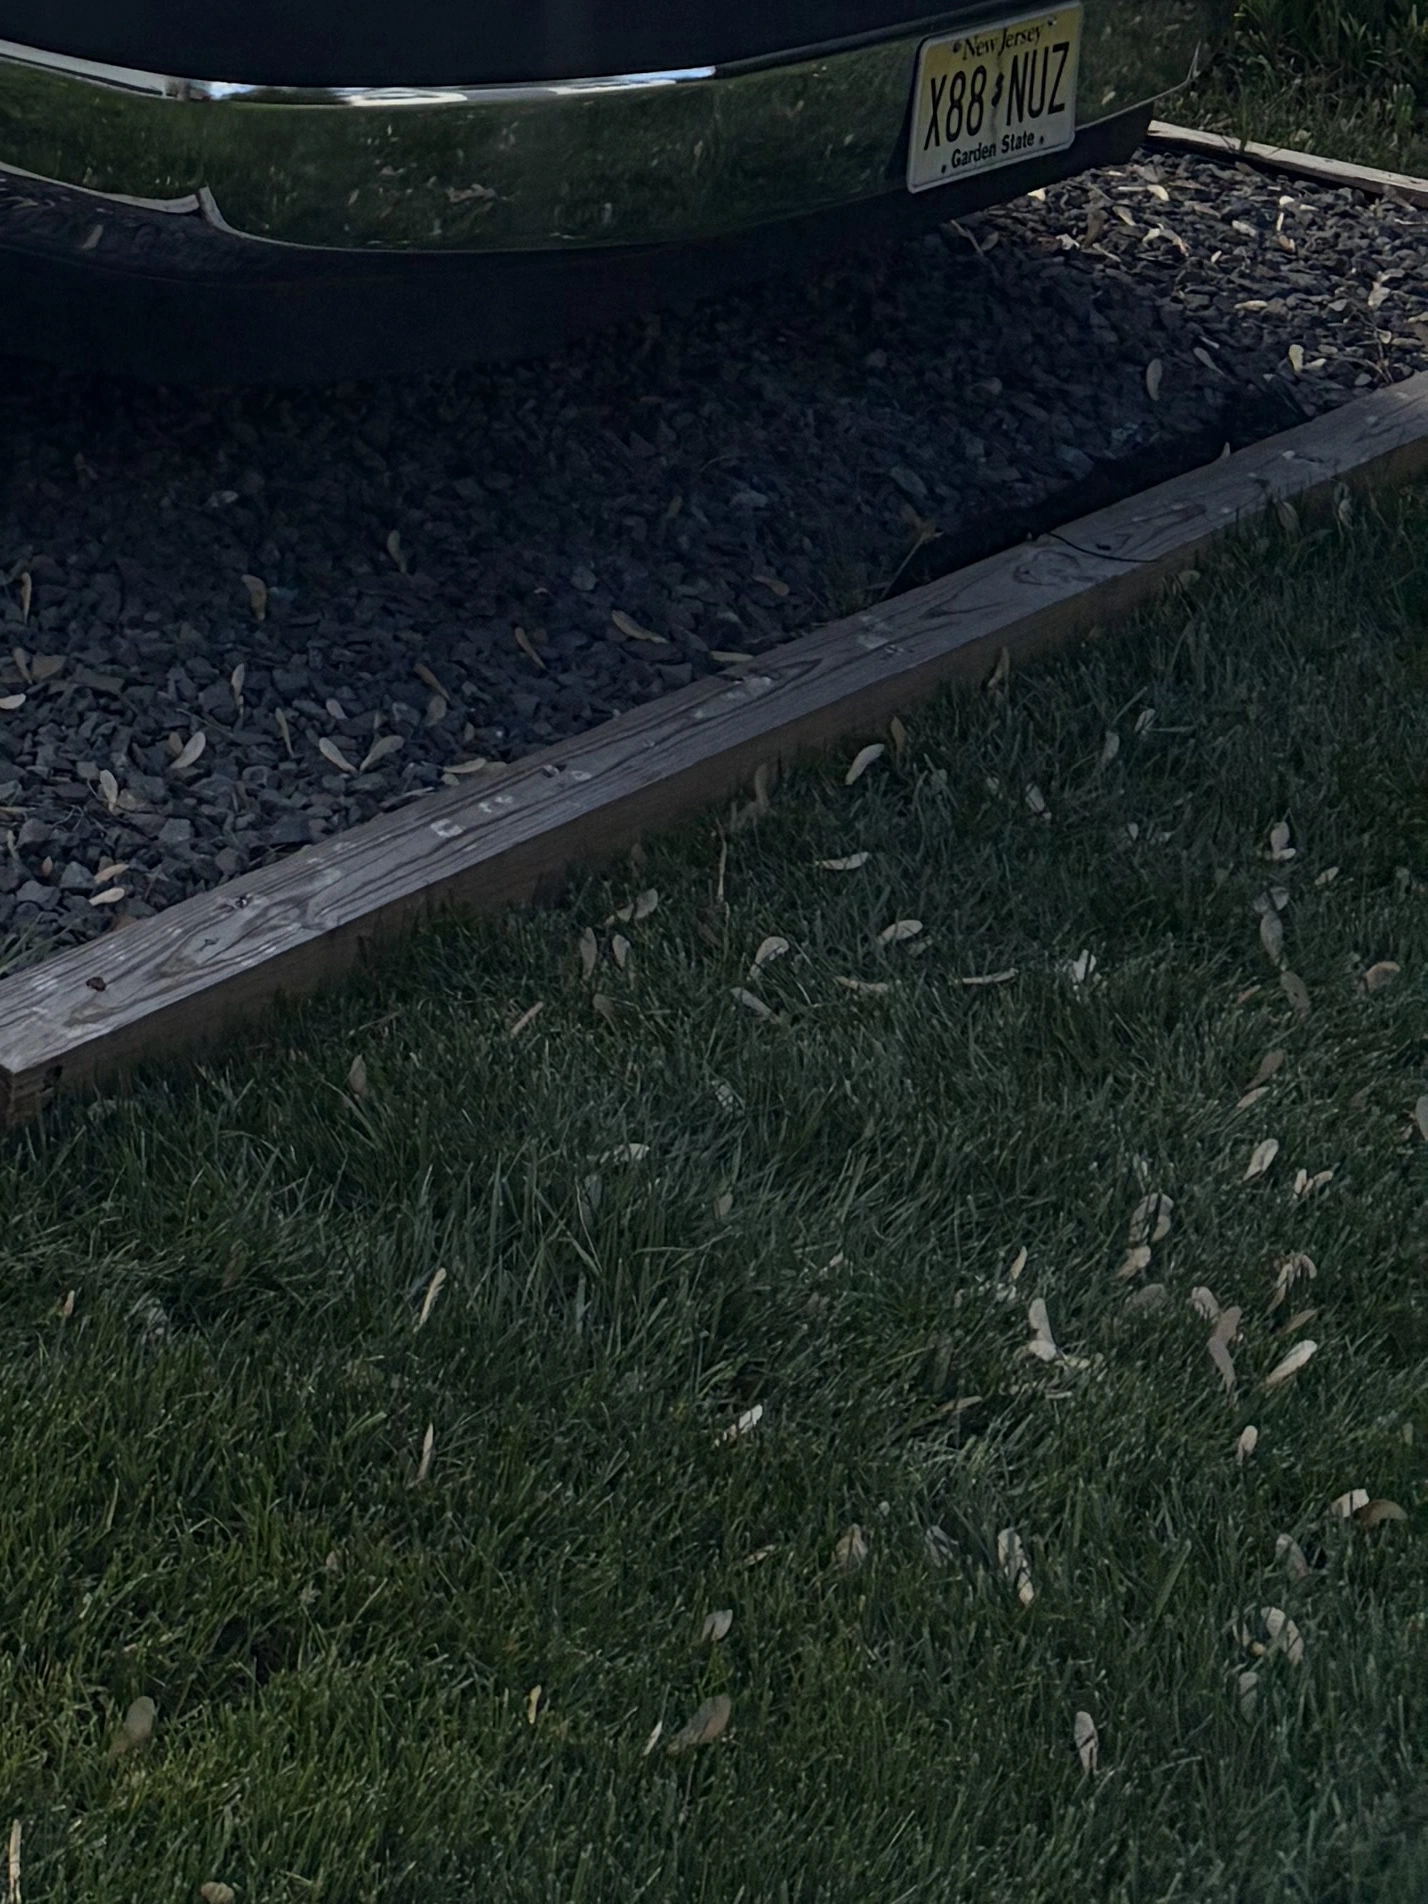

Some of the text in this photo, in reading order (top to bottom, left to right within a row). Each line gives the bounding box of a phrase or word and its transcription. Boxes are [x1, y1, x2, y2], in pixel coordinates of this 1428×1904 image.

[962, 25, 1044, 61] New Jersey
[923, 41, 1071, 151] X88 NUZ
[951, 131, 1035, 169] Garden State
